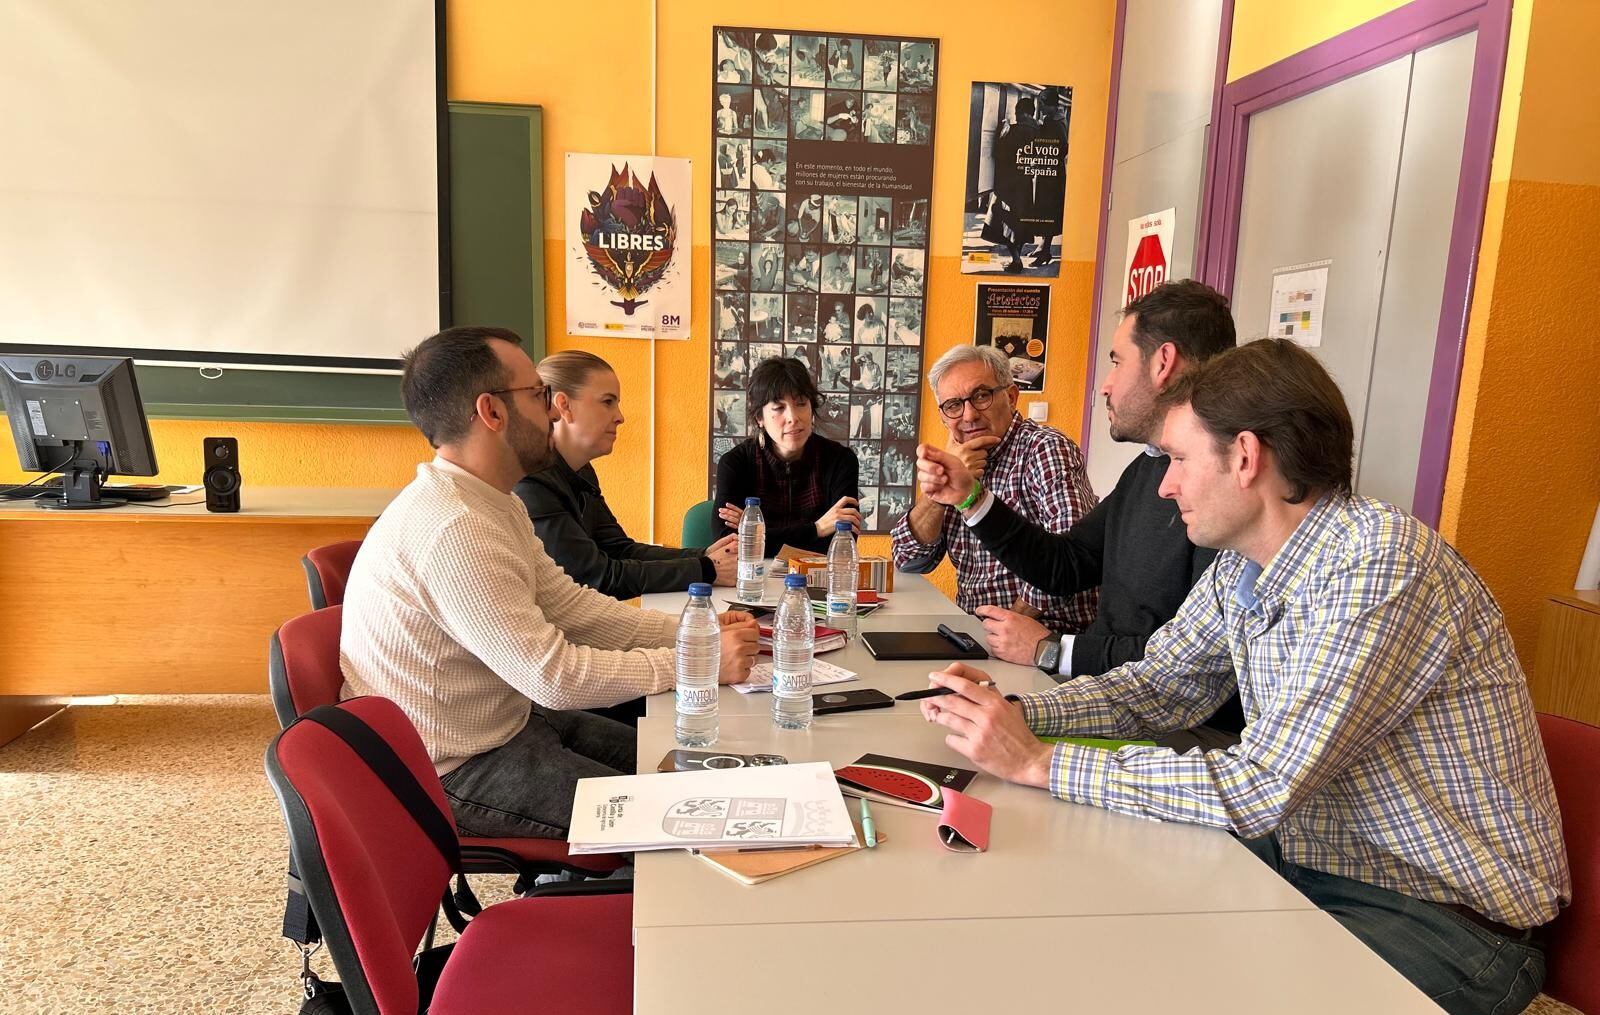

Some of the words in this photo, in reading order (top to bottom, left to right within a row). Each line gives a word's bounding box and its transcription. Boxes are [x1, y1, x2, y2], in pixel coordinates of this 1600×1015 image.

[1023, 141, 1033, 155] el
[1035, 145, 1060, 156] voto
[1015, 148, 1059, 167] femenino
[795, 170, 818, 178] millones
[1024, 166, 1057, 177] España
[599, 232, 664, 251] LIBRES
[1128, 265, 1164, 303] STOP
[661, 314, 681, 326] 8M
[55, 364, 76, 377] LG
